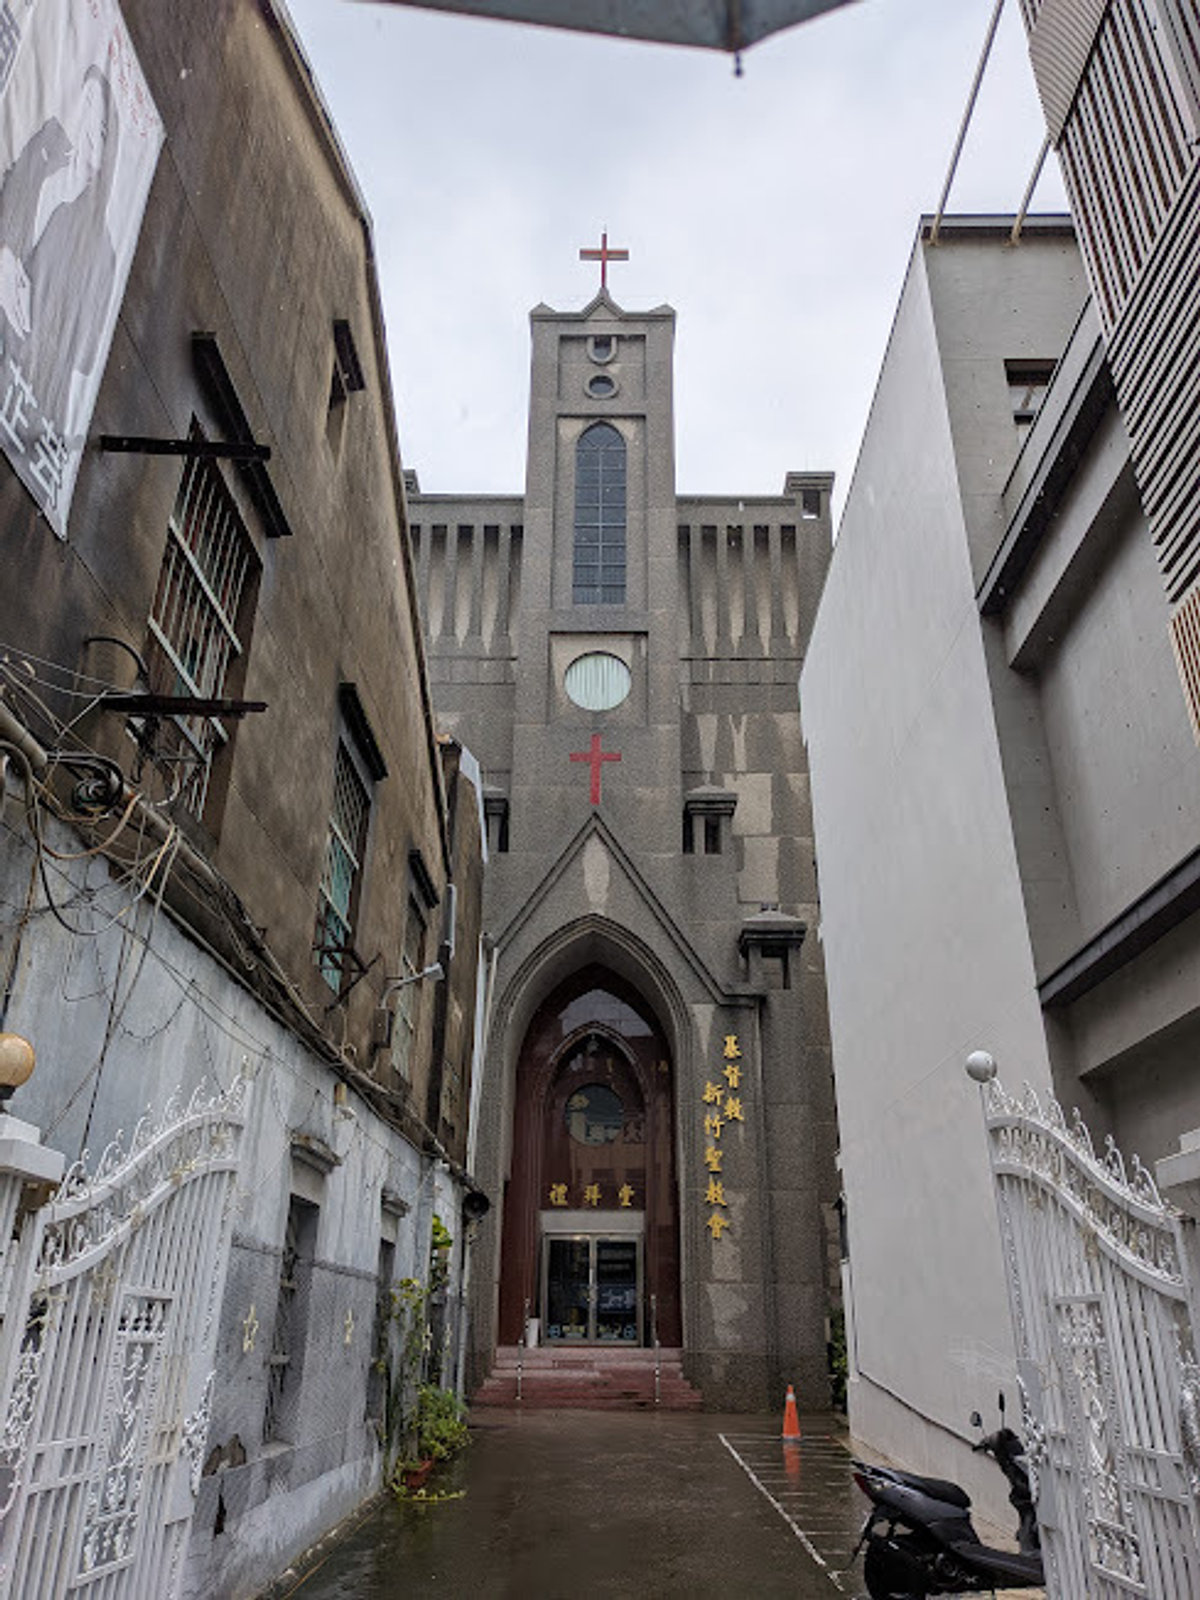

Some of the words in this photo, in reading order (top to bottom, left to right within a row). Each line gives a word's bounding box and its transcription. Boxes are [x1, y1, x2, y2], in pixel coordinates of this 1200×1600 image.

[0, 338, 67, 509] 芷芸
[722, 1035, 744, 1121] 基督教
[702, 1081, 729, 1239] 新竹聖教會
